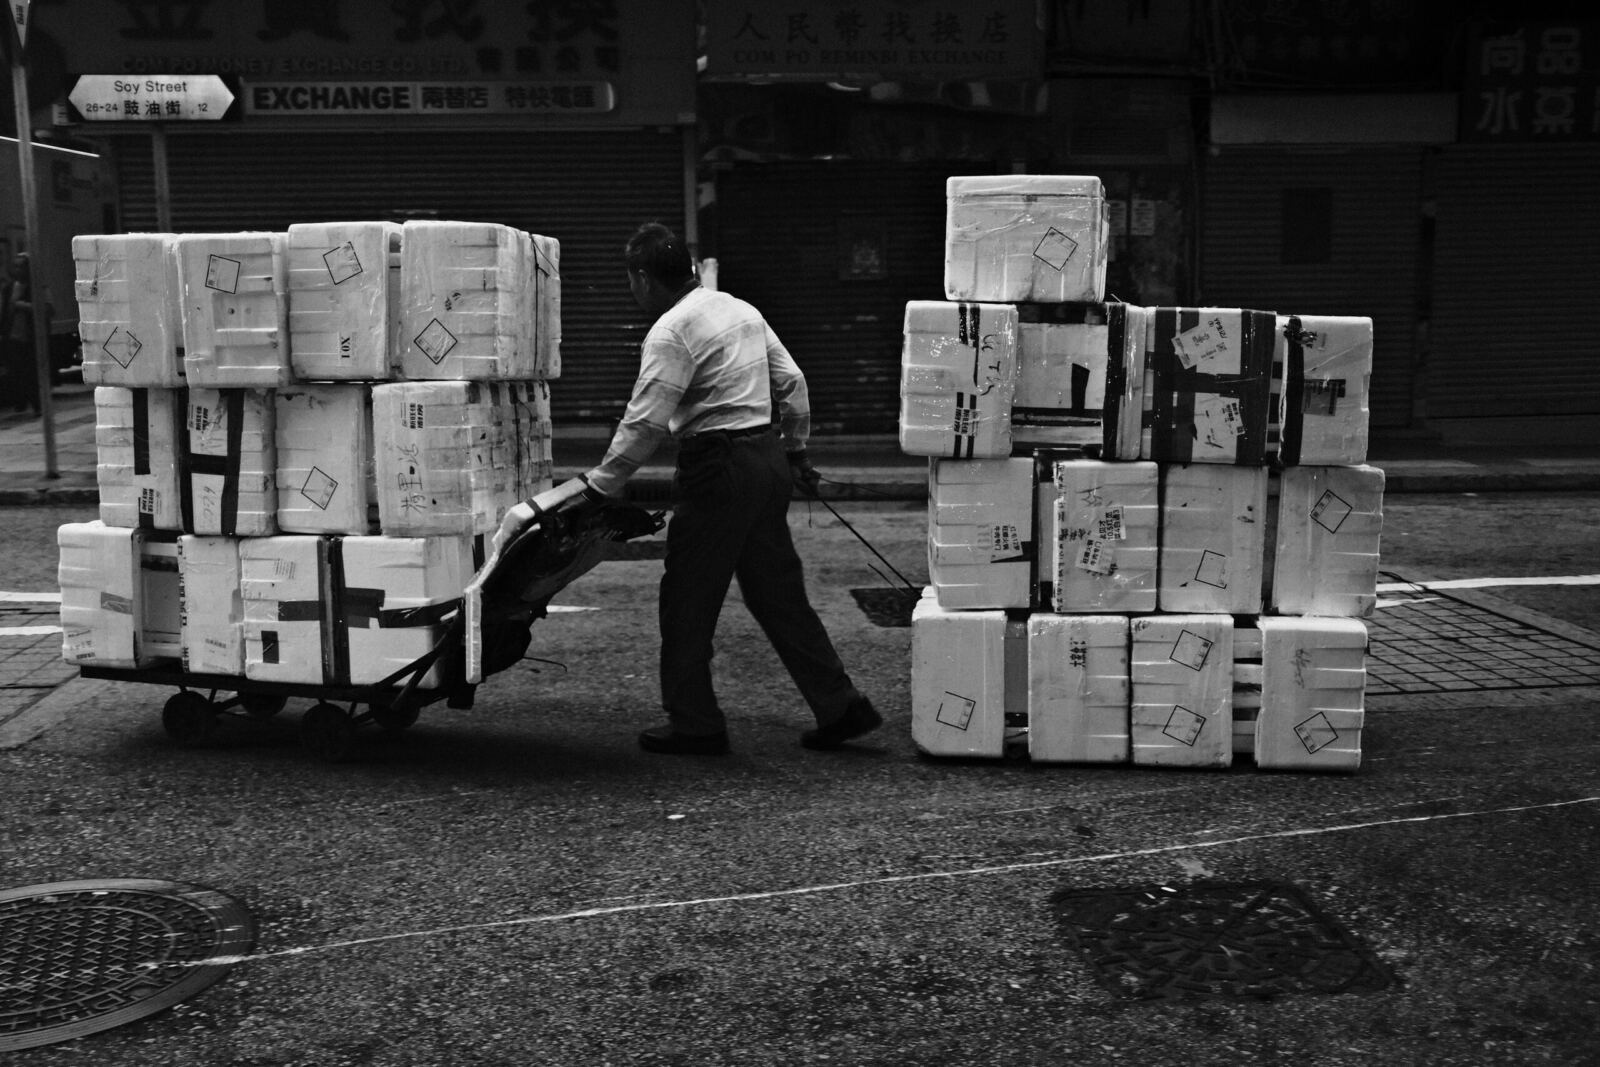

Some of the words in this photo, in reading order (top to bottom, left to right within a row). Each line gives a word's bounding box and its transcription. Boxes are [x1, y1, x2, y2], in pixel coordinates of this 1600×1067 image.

[733, 9, 1008, 46] 人民幣找換店
[733, 50, 776, 63] COM
[786, 50, 811, 63] PO
[910, 50, 1008, 63] EXCHANGE
[202, 57, 273, 73] MONEY
[280, 57, 384, 73] EXCHANGE
[114, 80, 140, 94] Soy
[145, 80, 187, 93] Street
[253, 86, 410, 110] EXCHANGE
[86, 103, 118, 113] 26-24
[197, 103, 208, 112] 12
